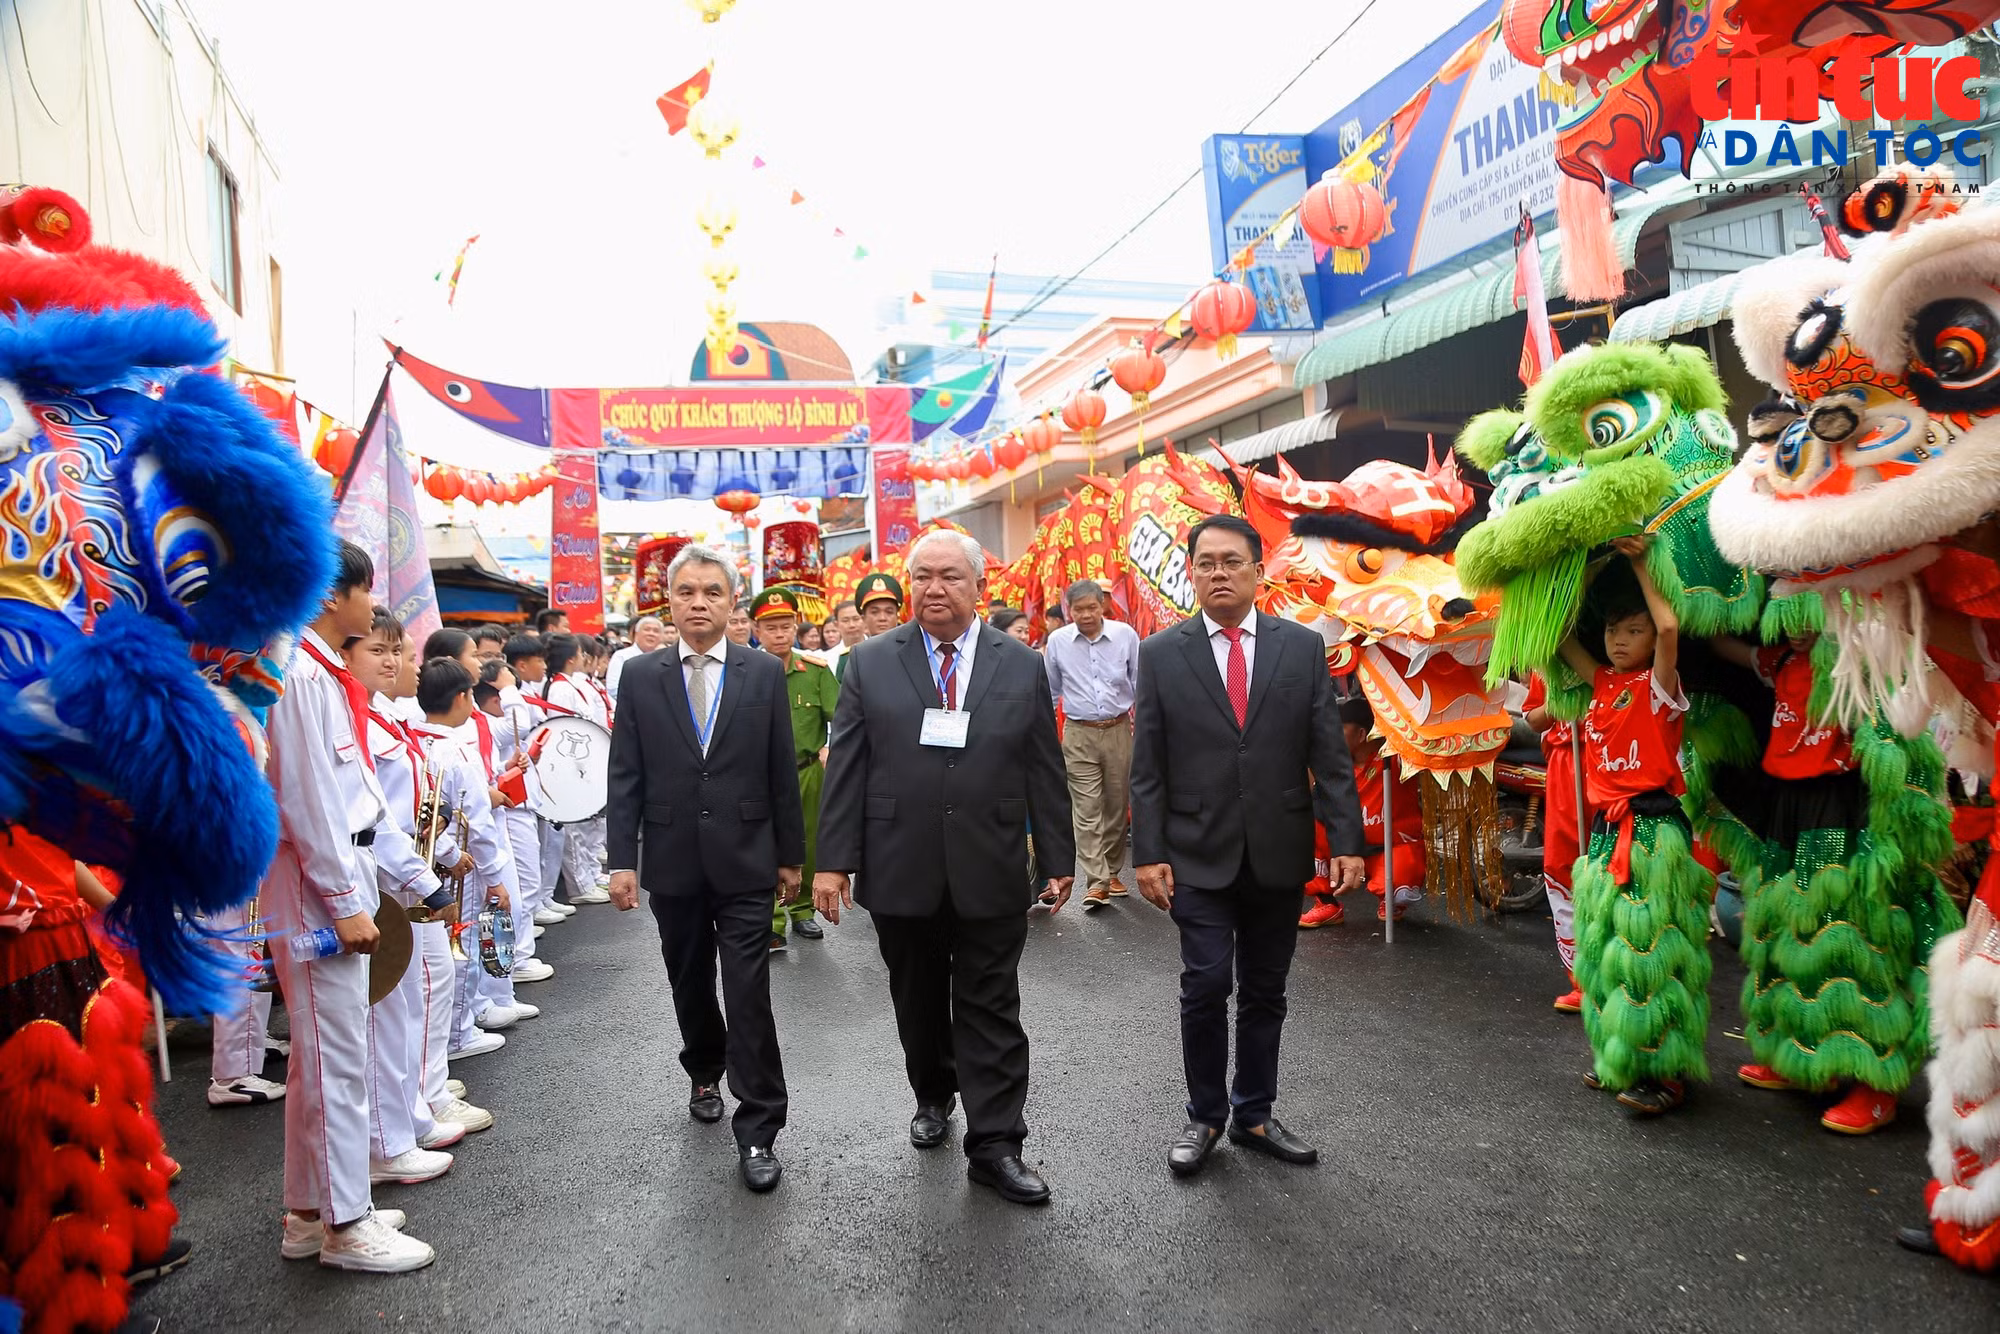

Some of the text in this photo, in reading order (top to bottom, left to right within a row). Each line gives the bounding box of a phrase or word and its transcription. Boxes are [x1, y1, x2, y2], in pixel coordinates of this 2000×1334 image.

[1243, 141, 1301, 174] Tiger
[1431, 191, 1458, 218] CHUYÊN
[1459, 182, 1478, 203] CUNG
[1503, 165, 1510, 179] &
[1508, 172, 1534, 198] DUYÊN
[610, 396, 858, 433] CHÚC QUÝ KHÁCH THƯỢNG LỘ BÌNH AN
